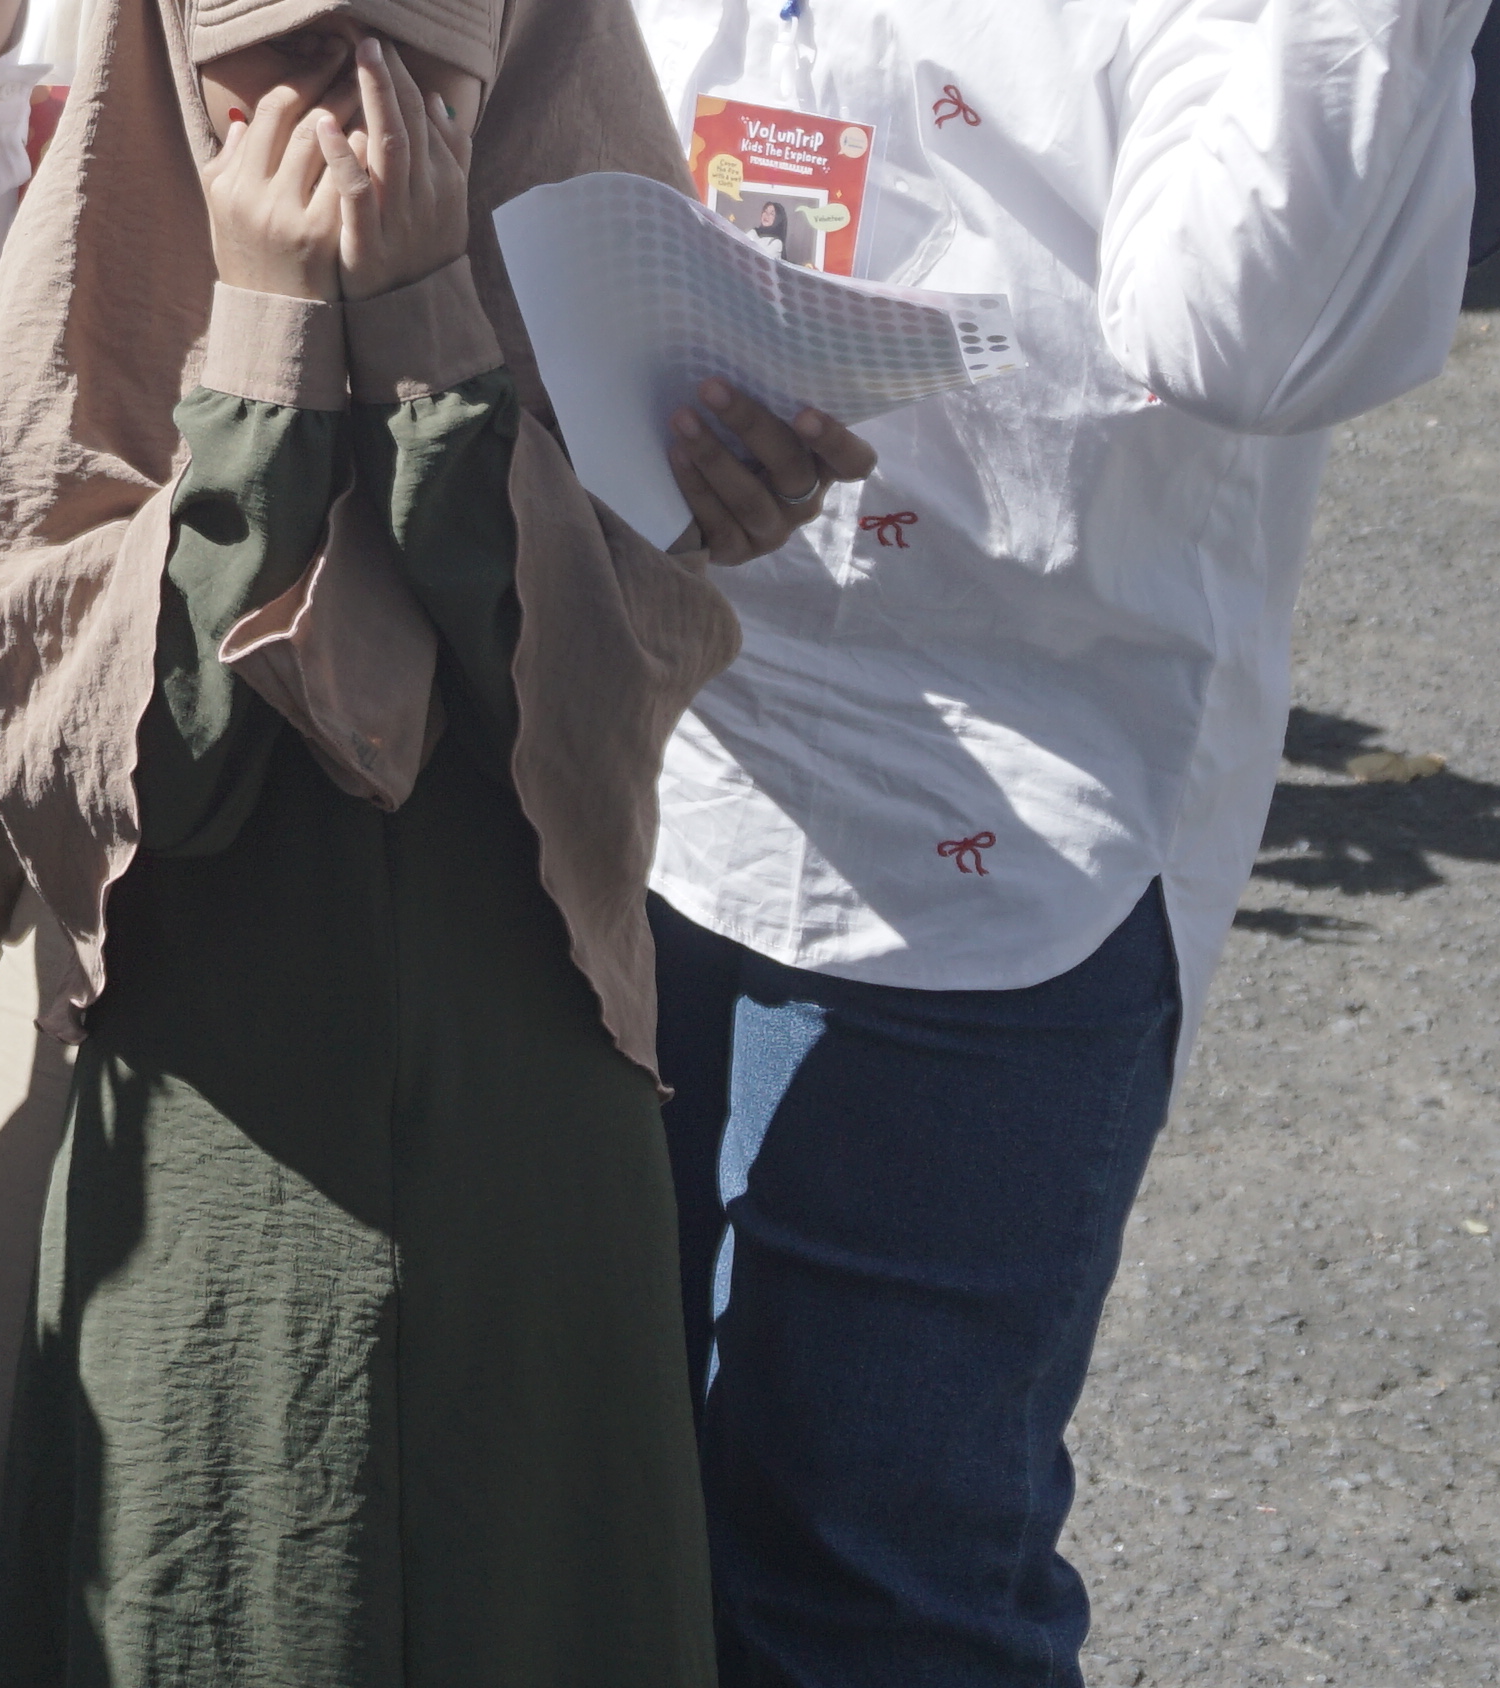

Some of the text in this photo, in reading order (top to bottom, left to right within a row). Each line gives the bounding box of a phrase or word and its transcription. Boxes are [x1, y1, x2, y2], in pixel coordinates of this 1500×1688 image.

[741, 137, 828, 166] Kids The Explorer
